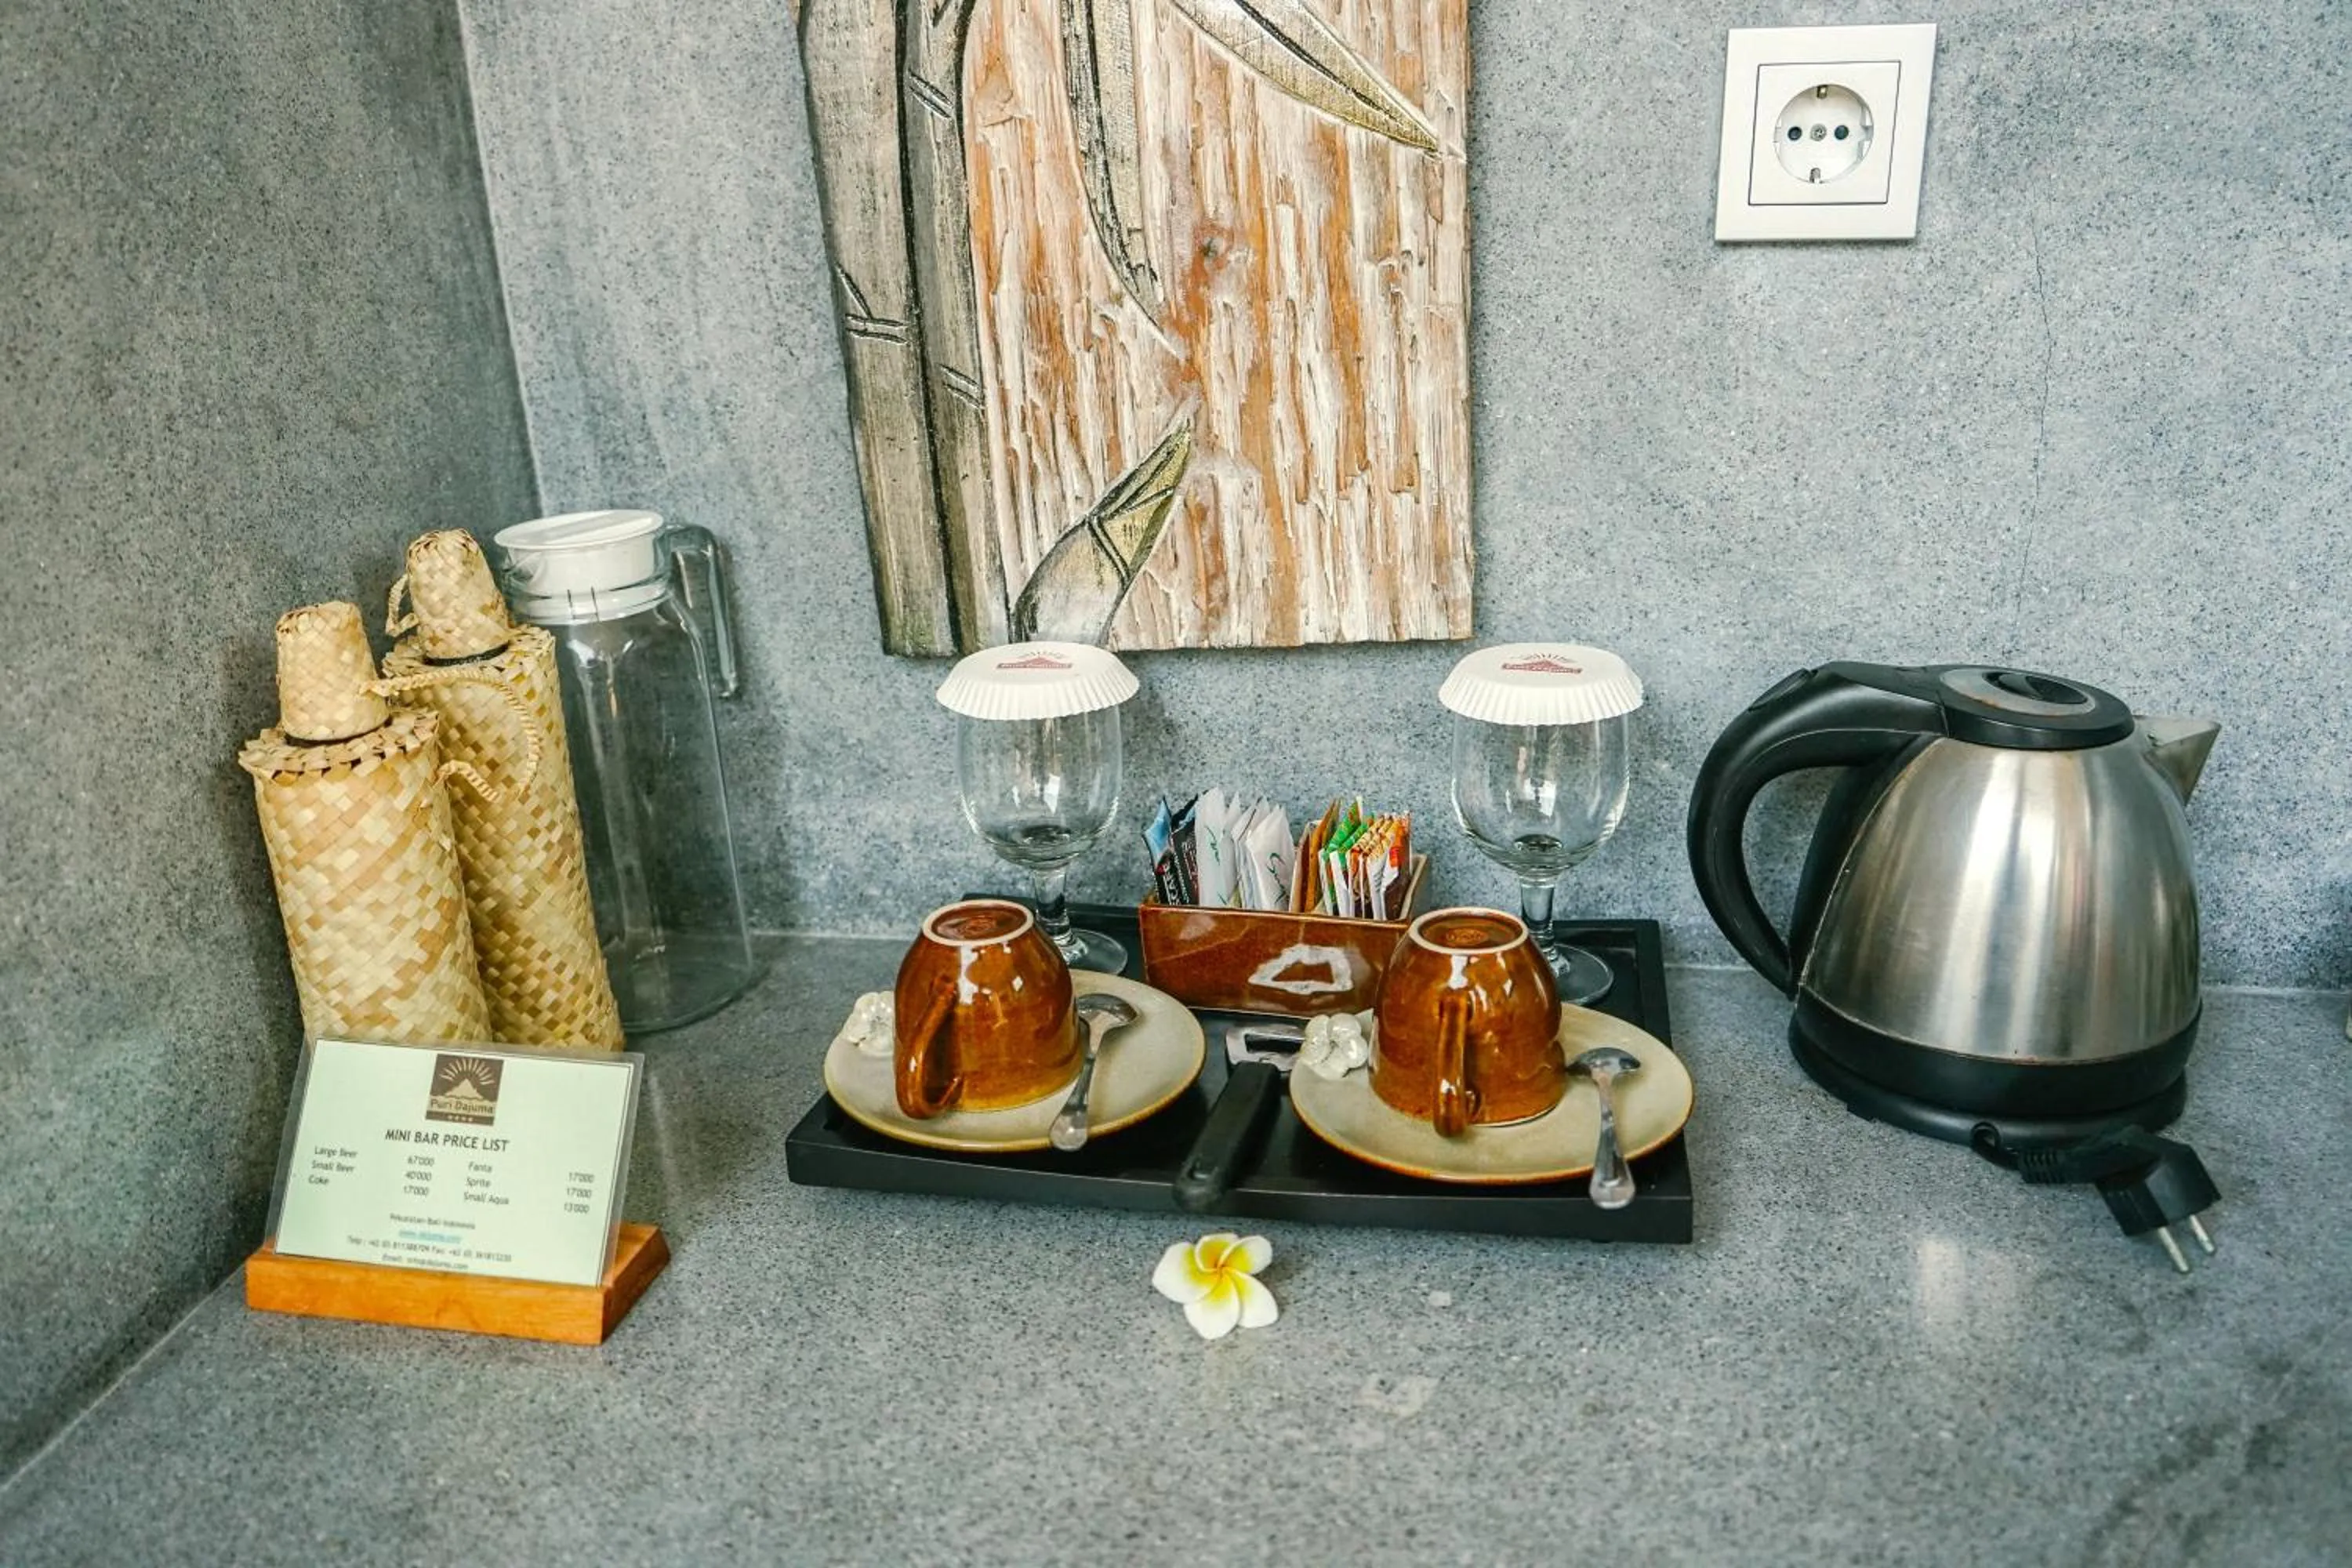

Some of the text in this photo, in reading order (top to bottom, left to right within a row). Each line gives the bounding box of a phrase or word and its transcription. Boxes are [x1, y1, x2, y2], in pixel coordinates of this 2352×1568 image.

[430, 1098, 494, 1113] Puri Dajuma
[385, 1129, 510, 1152] MINI BAR PRICE LIST
[314, 1146, 358, 1157] Large Beer
[312, 1160, 354, 1172] Small Beer
[468, 1161, 492, 1173] Fanta
[308, 1174, 329, 1185] Coke
[466, 1177, 491, 1188] Sprite
[464, 1192, 509, 1205] Small Aqua
